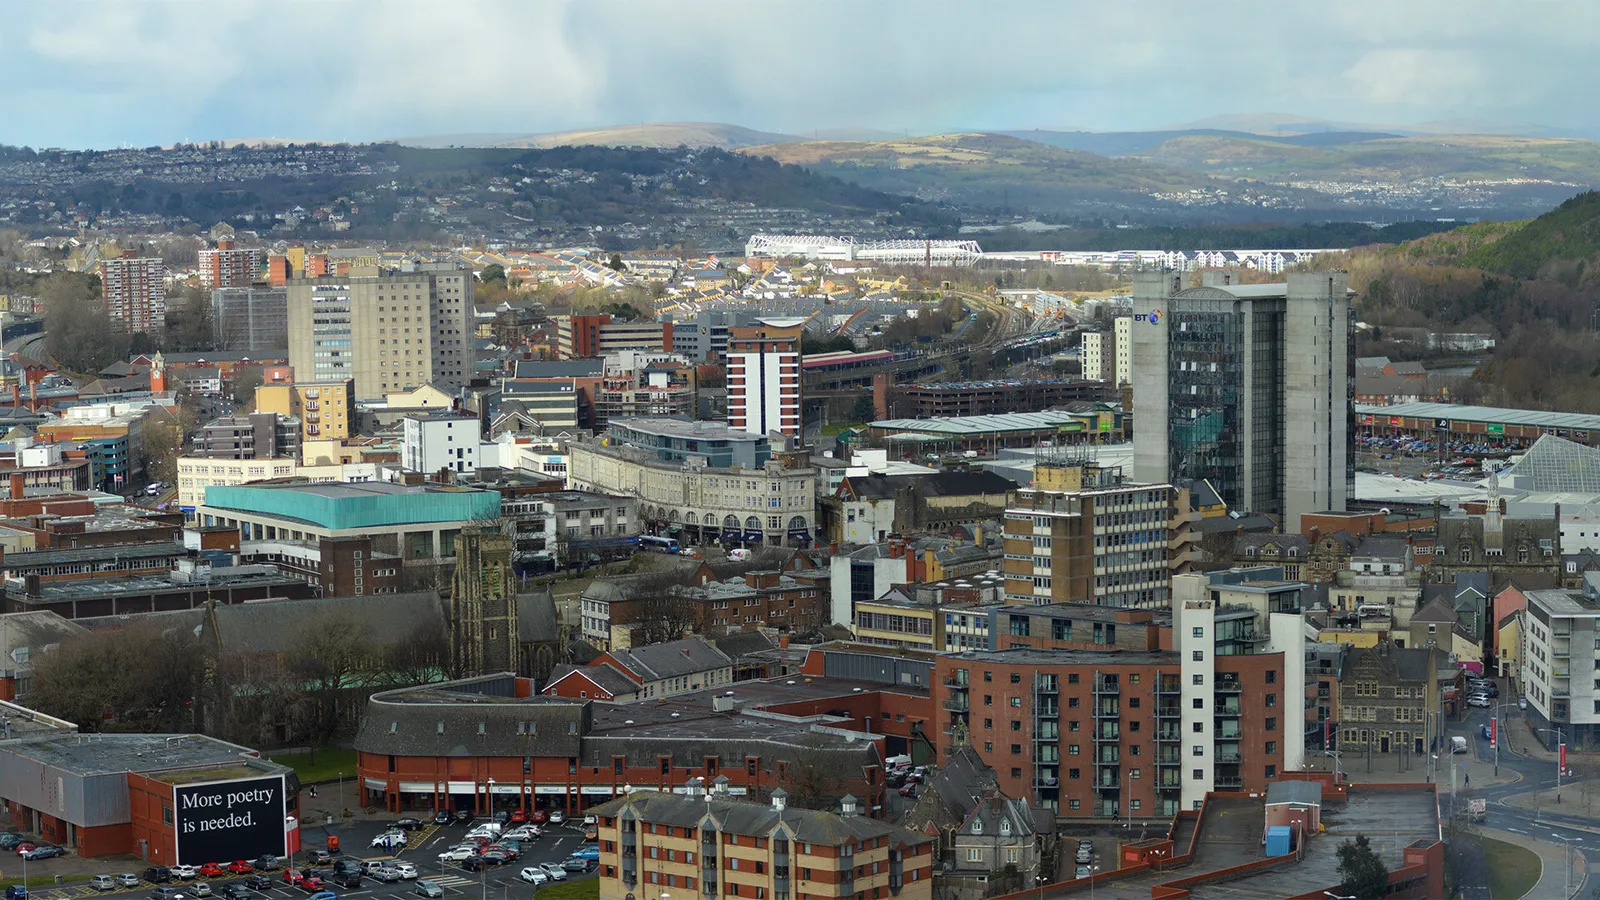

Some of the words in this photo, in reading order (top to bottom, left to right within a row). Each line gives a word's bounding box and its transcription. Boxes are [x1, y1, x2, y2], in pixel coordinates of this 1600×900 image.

[182, 793, 223, 809] More
[227, 788, 274, 808] poetry
[183, 818, 196, 833] is
[200, 811, 257, 831] needed.
